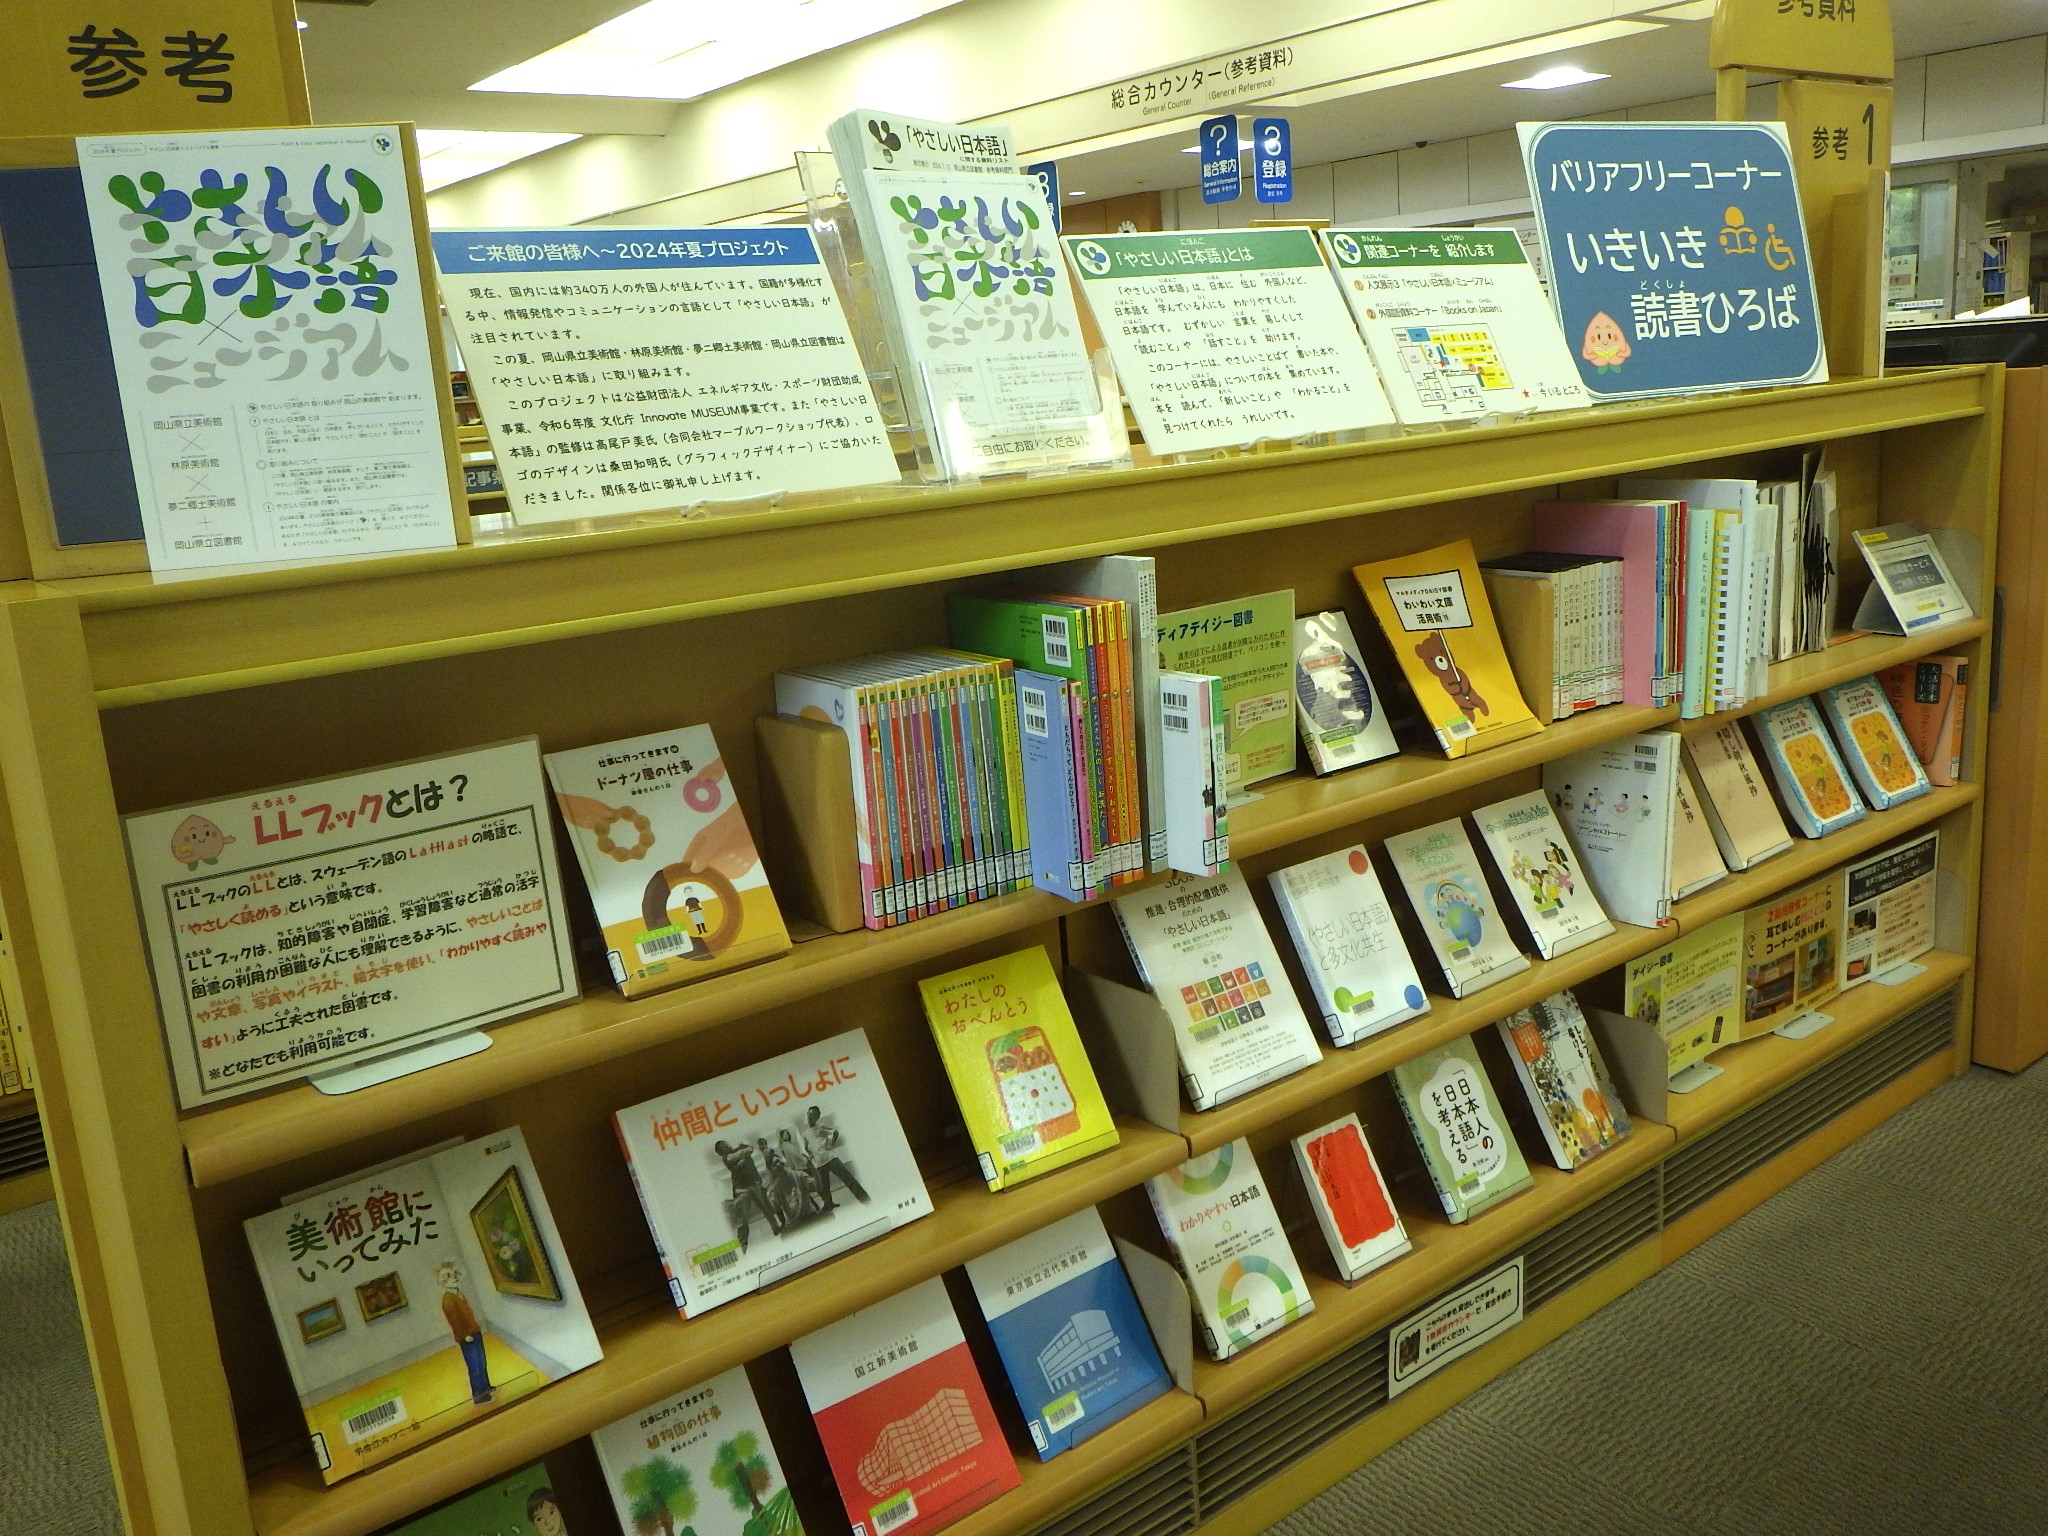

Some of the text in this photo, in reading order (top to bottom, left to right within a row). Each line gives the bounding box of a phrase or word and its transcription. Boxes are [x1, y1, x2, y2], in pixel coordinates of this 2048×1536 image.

[68, 25, 235, 103] 参考
[1143, 98, 1192, 116] General Counter
[907, 125, 1008, 157] 「やさしい日本語」
[1812, 103, 1874, 165] 参考 1
[1203, 158, 1236, 178] 総合案内
[1262, 160, 1286, 178] 登録
[1550, 159, 1782, 193] バリアフリーコーナー
[1115, 246, 1254, 268] 「やさしい日本語」とは
[1364, 243, 1495, 260] 関連コーナーを 紹介します
[1566, 227, 1707, 274] いきいき
[1640, 279, 1686, 289] どくしょ
[1114, 306, 1149, 317] 日本語を
[1233, 295, 1297, 308] わかりやすくした
[1631, 284, 1800, 341] 読書ひろば
[471, 328, 581, 344] 注目されています。
[1184, 319, 1225, 331] むずかしい
[1232, 316, 1258, 328] 言葉を
[640, 411, 687, 423] Innovate
[1156, 403, 1173, 414] 本を
[1164, 417, 1234, 434] 見つけてくれたら
[1403, 597, 1454, 610] わいわい文庫
[597, 759, 693, 791] ドーナツ屋の仕事
[251, 794, 296, 811] えるえる
[254, 774, 468, 845] LLブックとは？
[180, 882, 382, 935] 「やさしく読める」という意味です。
[1145, 883, 1230, 919] 推進・合理的配慮提供
[1163, 909, 1232, 938] 「やさしい日本語」
[1320, 932, 1388, 971] と多文化共生
[946, 984, 1006, 1014] わたしの
[953, 997, 1028, 1035] おべんとう
[653, 1056, 857, 1152] 仲間と いっしょに
[1432, 1092, 1467, 1164] を考える
[1179, 1185, 1261, 1233] わかりやすい日本語
[286, 1190, 432, 1262] 美術館に
[297, 1216, 439, 1284] いってみた
[854, 1339, 920, 1379] 国立新美術館
